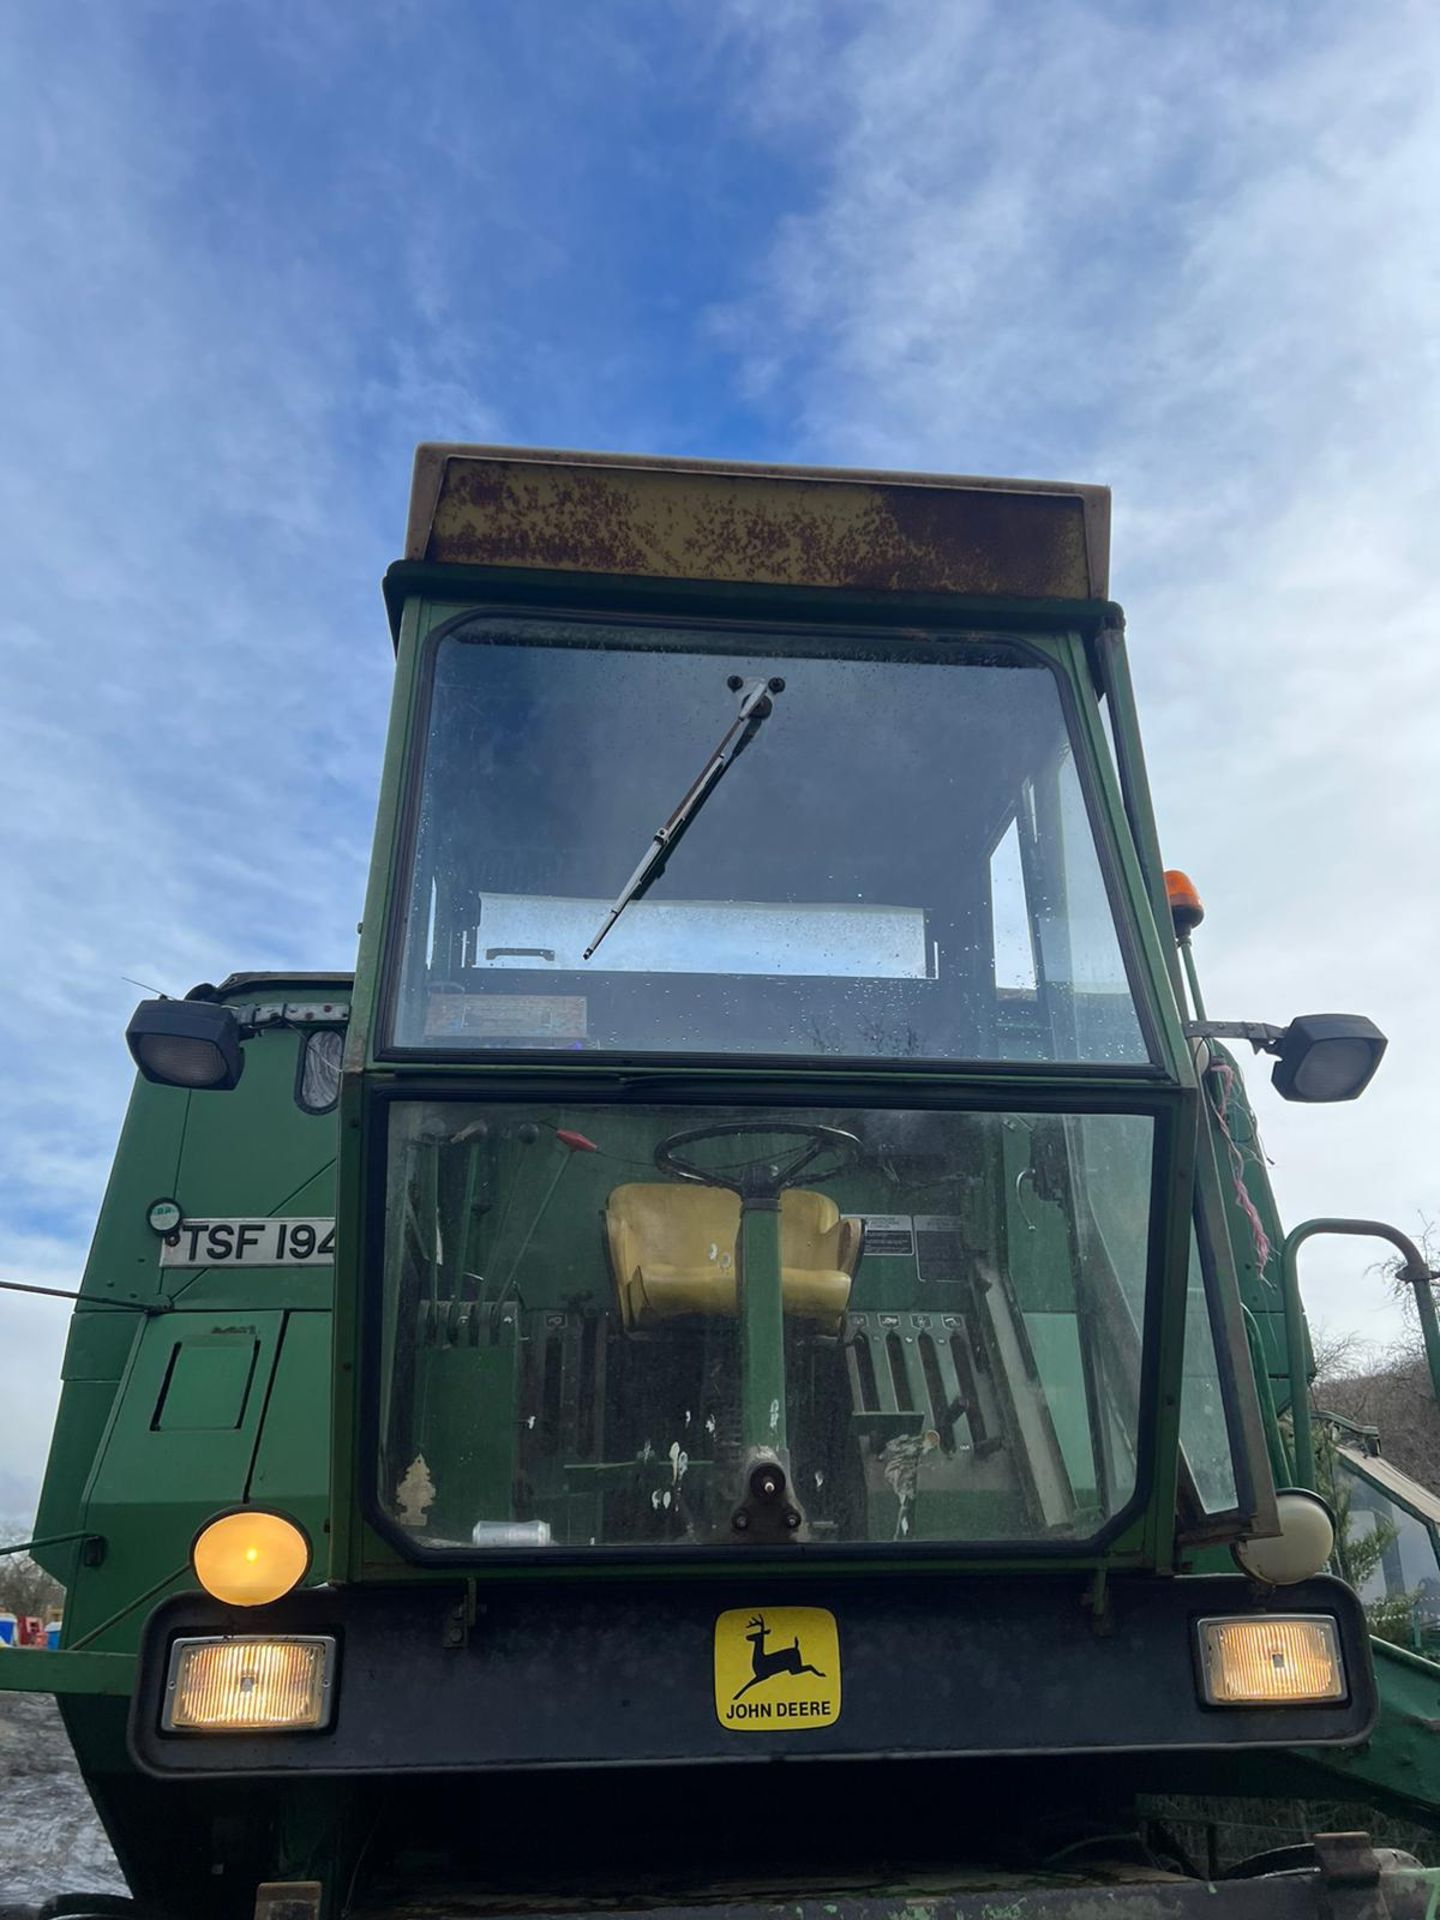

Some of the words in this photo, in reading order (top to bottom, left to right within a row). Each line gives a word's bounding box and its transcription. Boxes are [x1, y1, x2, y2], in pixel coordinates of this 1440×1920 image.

[183, 1224, 265, 1260] TSF
[726, 1703, 771, 1719] JOHN
[776, 1701, 831, 1717] DEERE
